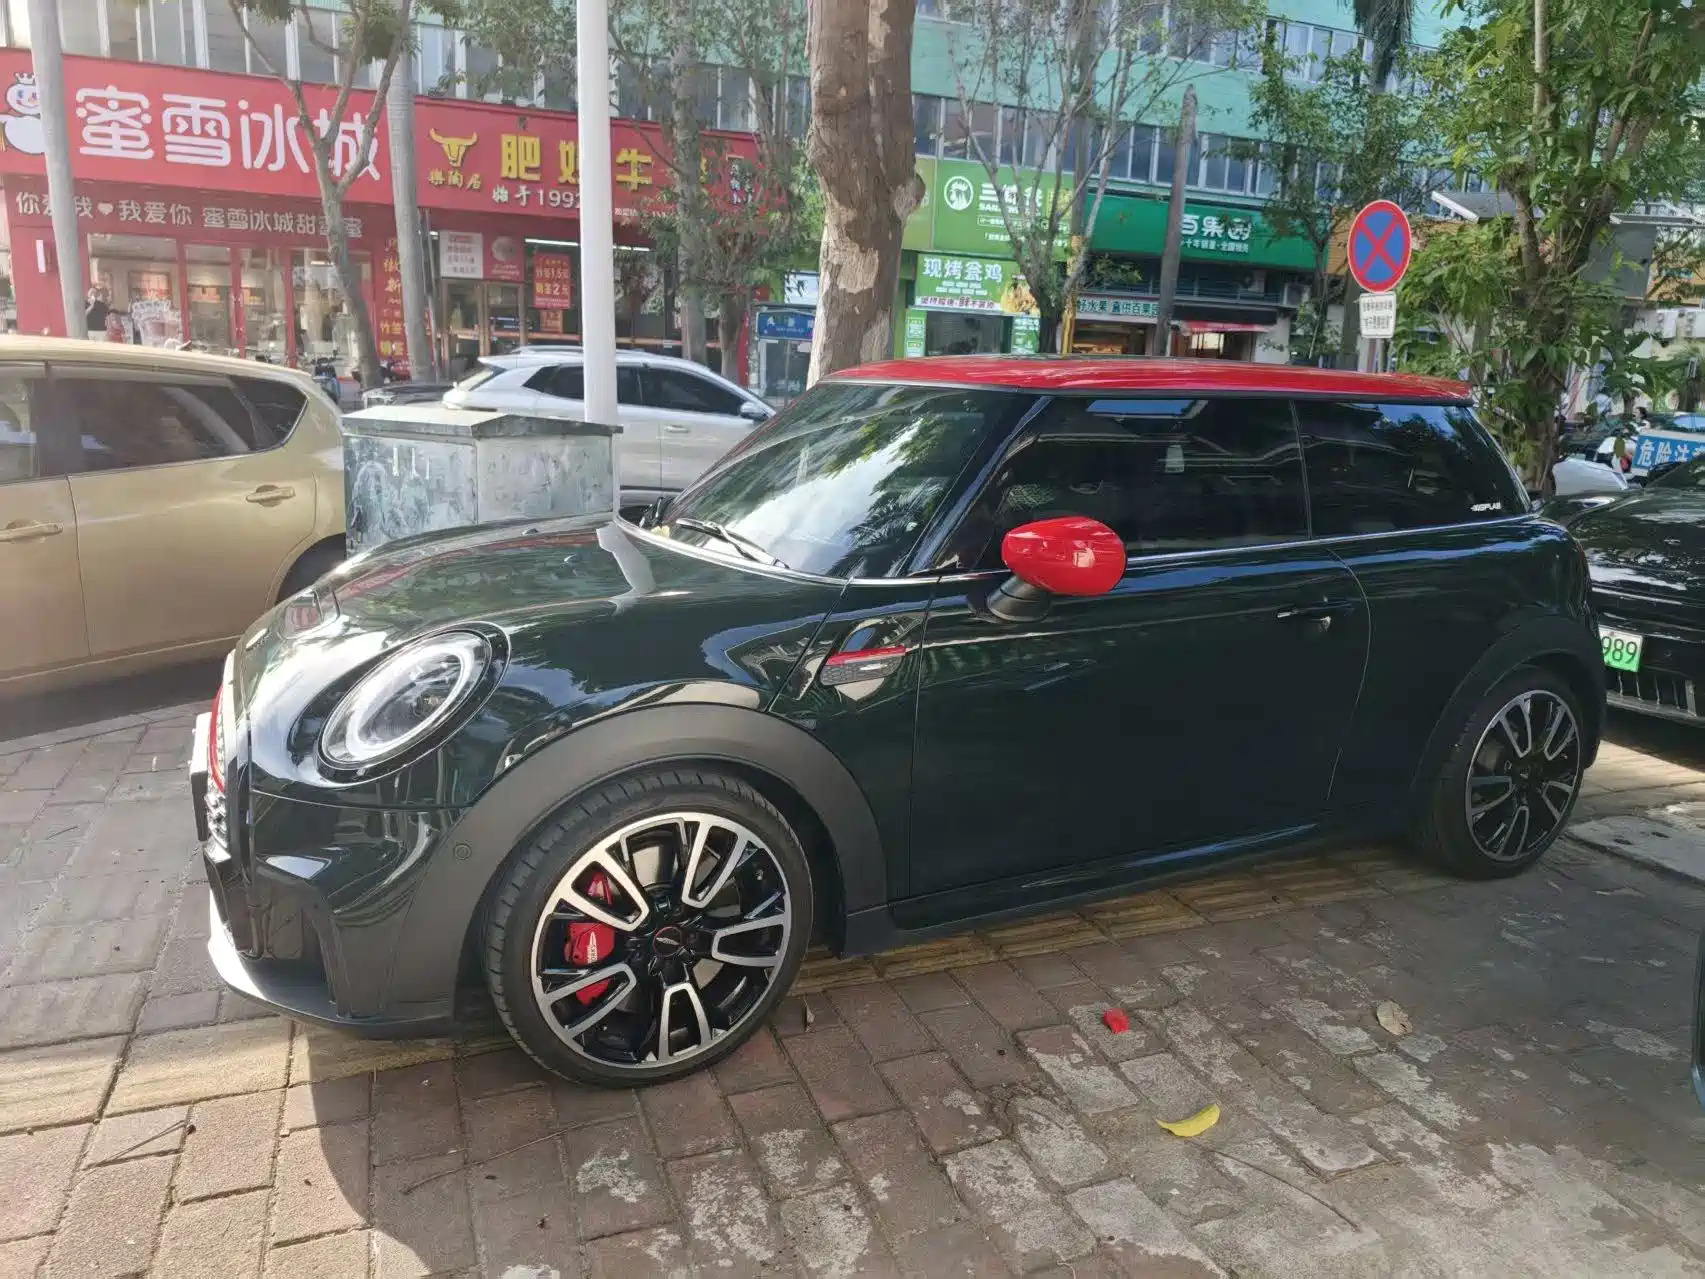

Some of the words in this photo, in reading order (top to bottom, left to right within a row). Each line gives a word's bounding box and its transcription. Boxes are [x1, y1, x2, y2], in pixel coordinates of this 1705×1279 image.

[75, 85, 381, 181] 蜜雪冰城
[1601, 635, 1638, 665] 989
